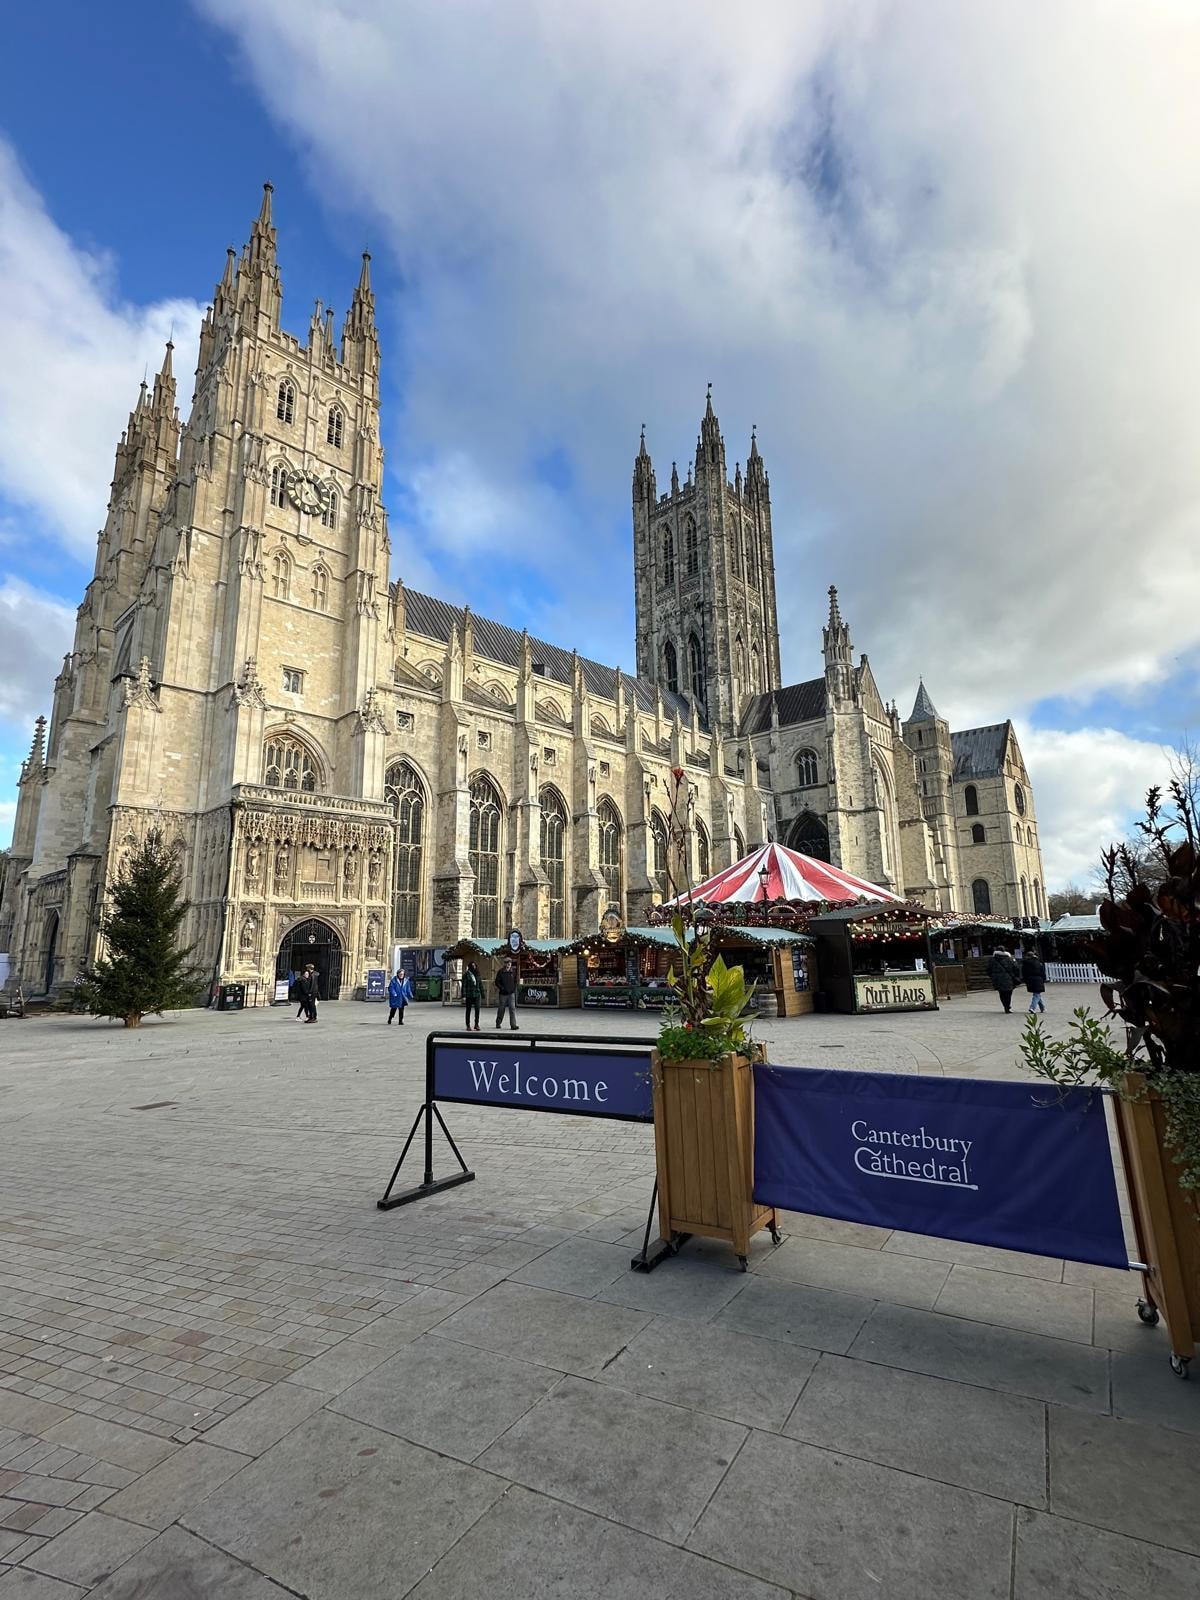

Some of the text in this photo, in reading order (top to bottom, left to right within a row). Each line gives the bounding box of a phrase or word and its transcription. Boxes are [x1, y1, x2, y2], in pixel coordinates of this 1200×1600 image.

[863, 985, 926, 1004] NUT HAUS
[467, 1060, 608, 1101] Welcome
[852, 1120, 972, 1162] Canterbury
[854, 1147, 978, 1190] Cathedral
